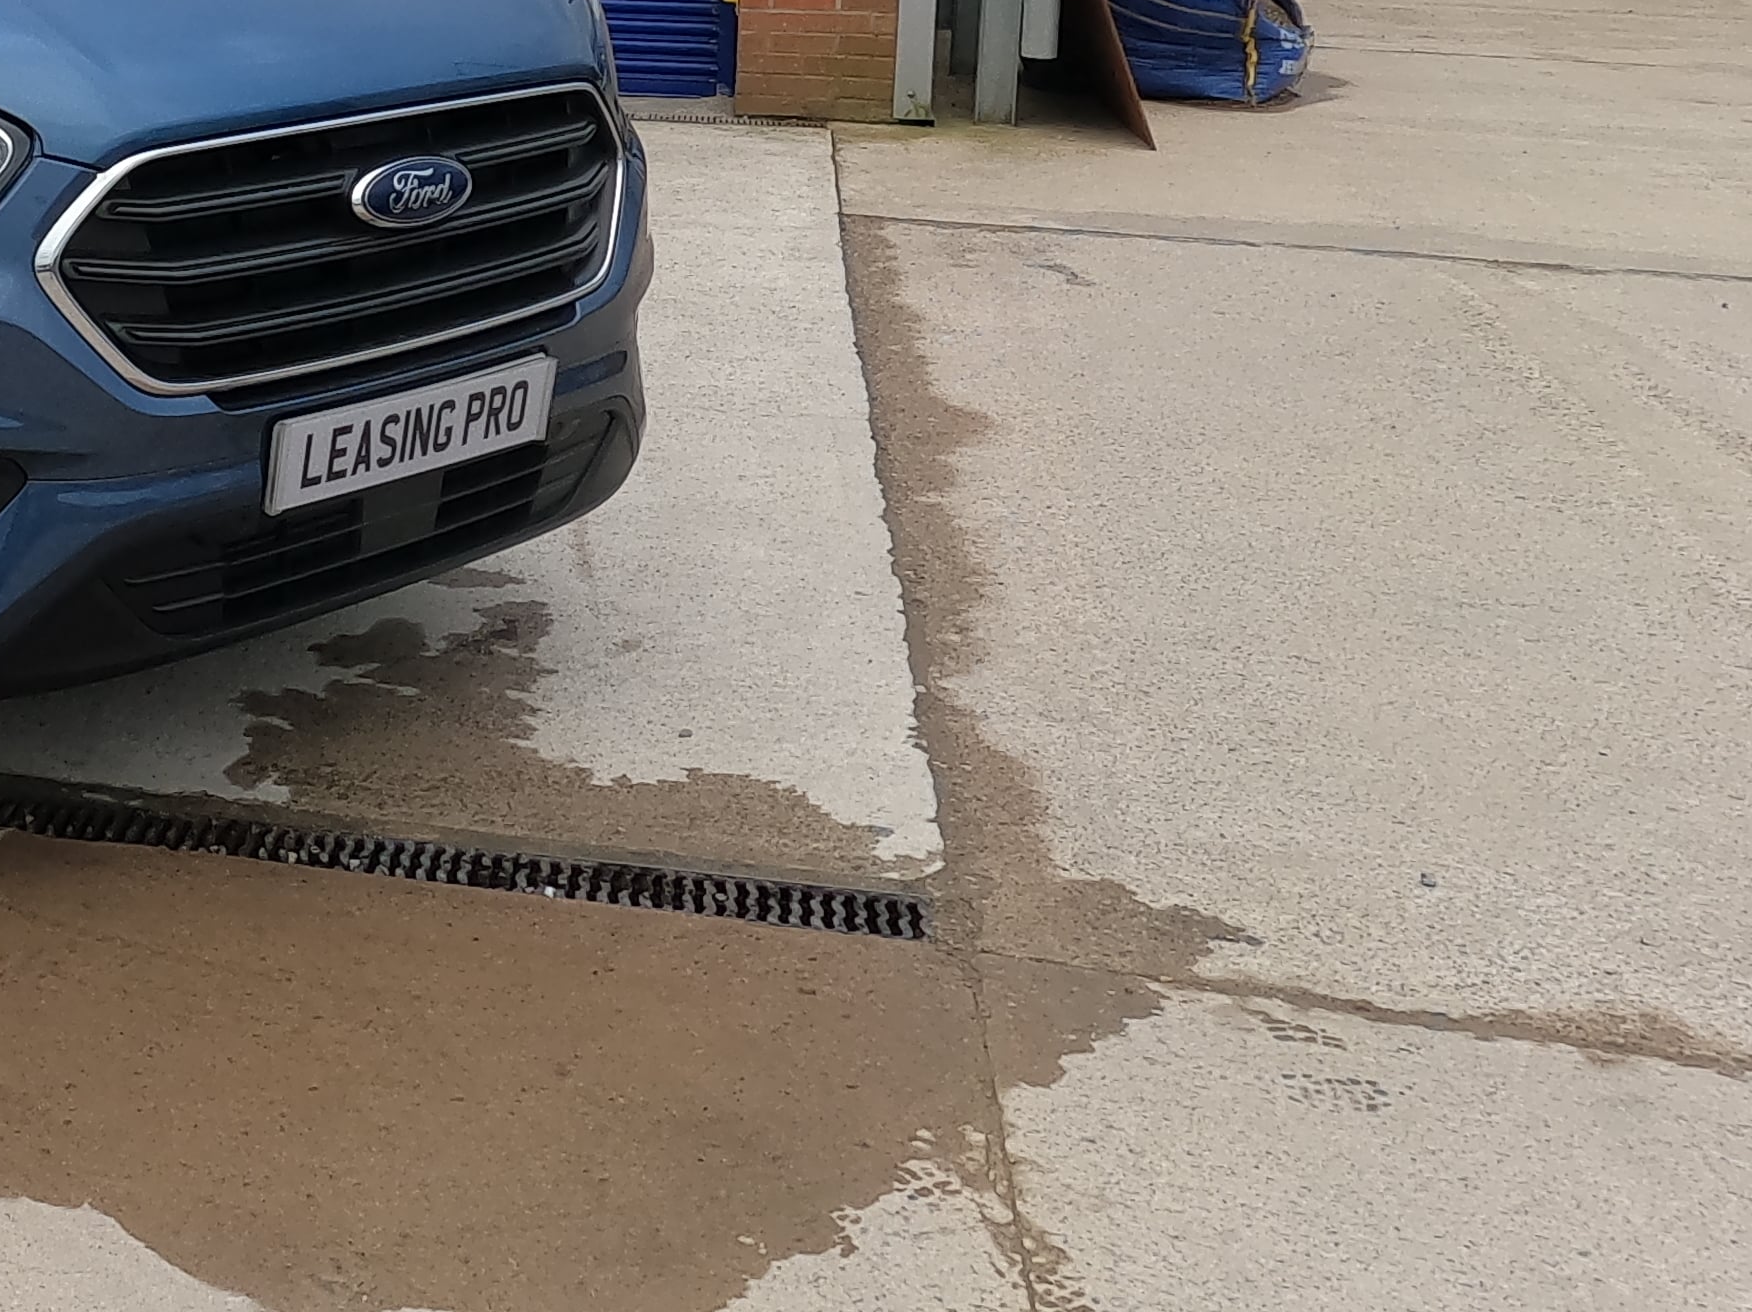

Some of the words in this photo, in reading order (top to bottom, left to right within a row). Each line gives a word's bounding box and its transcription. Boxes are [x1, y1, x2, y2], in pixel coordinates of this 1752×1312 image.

[389, 168, 454, 213] Ford
[300, 398, 456, 490] LEASING
[462, 379, 529, 447] PRO
